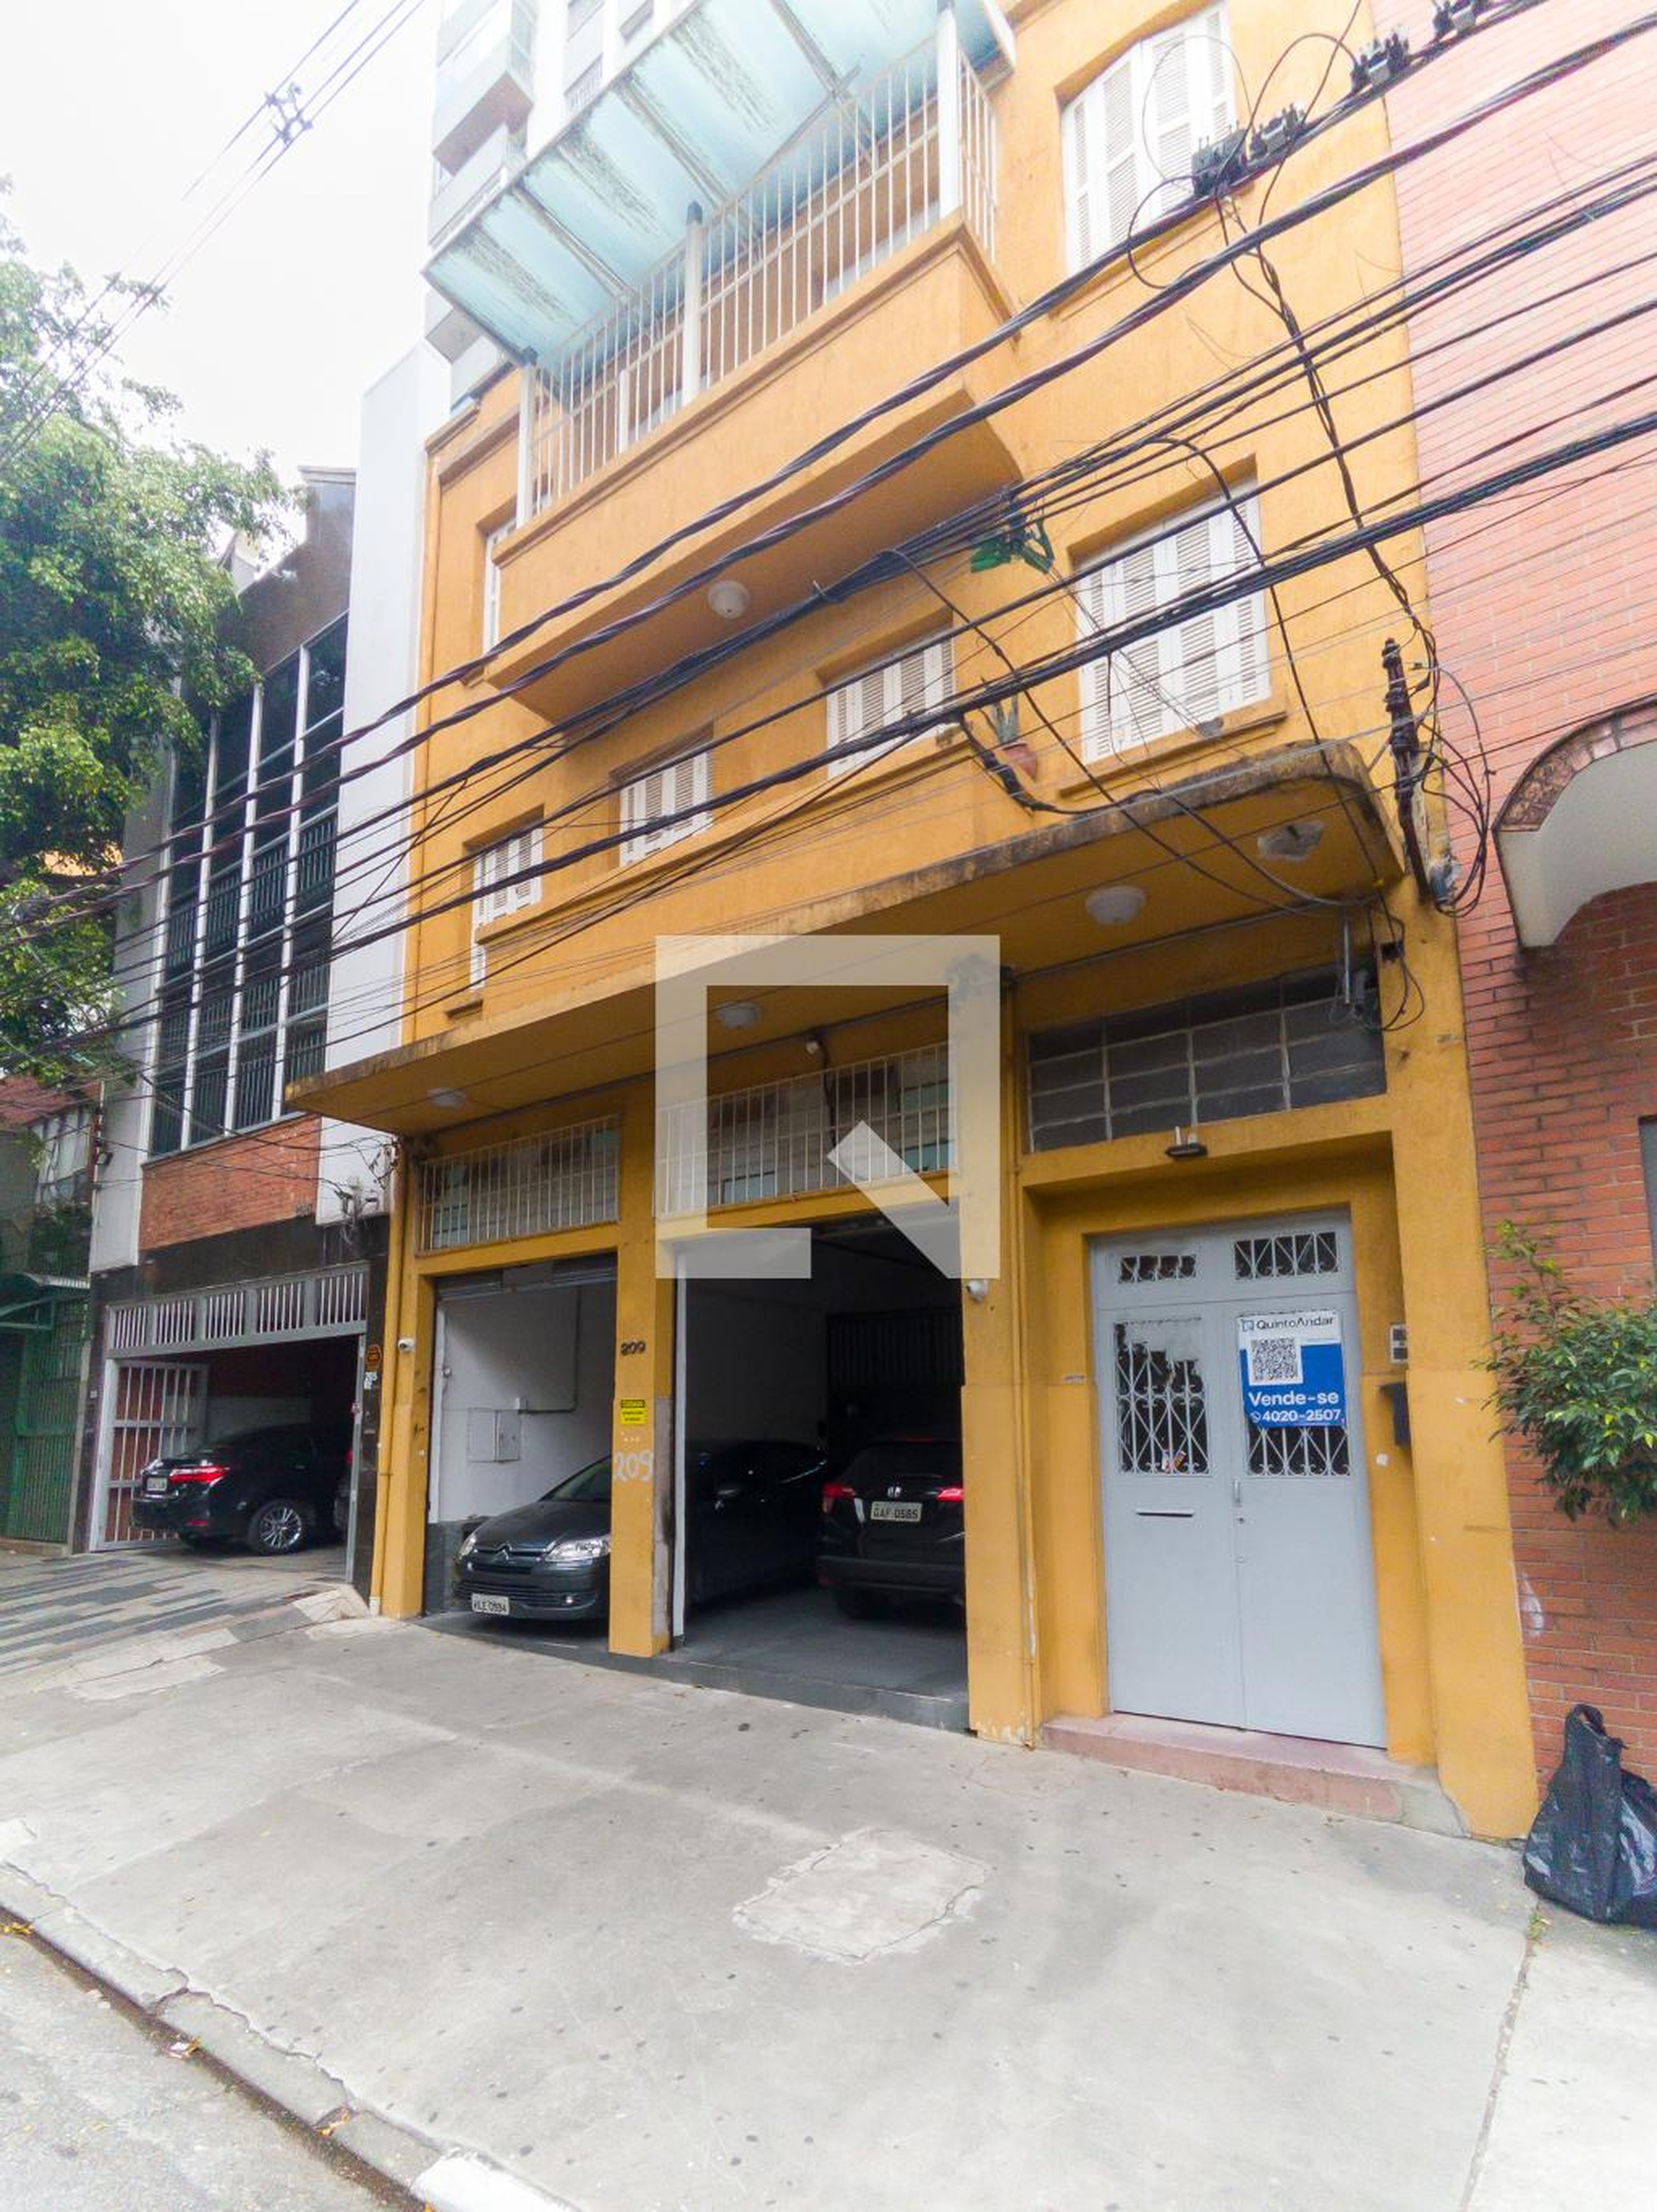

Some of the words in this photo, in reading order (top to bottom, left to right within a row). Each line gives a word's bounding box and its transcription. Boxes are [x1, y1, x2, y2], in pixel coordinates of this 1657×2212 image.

[1256, 1317, 1333, 1330] QuintoAndar
[621, 1341, 646, 1356] 209
[1248, 1390, 1339, 1406] Vende-se
[1262, 1409, 1341, 1422] 4020-2507
[614, 1449, 653, 1482] 209
